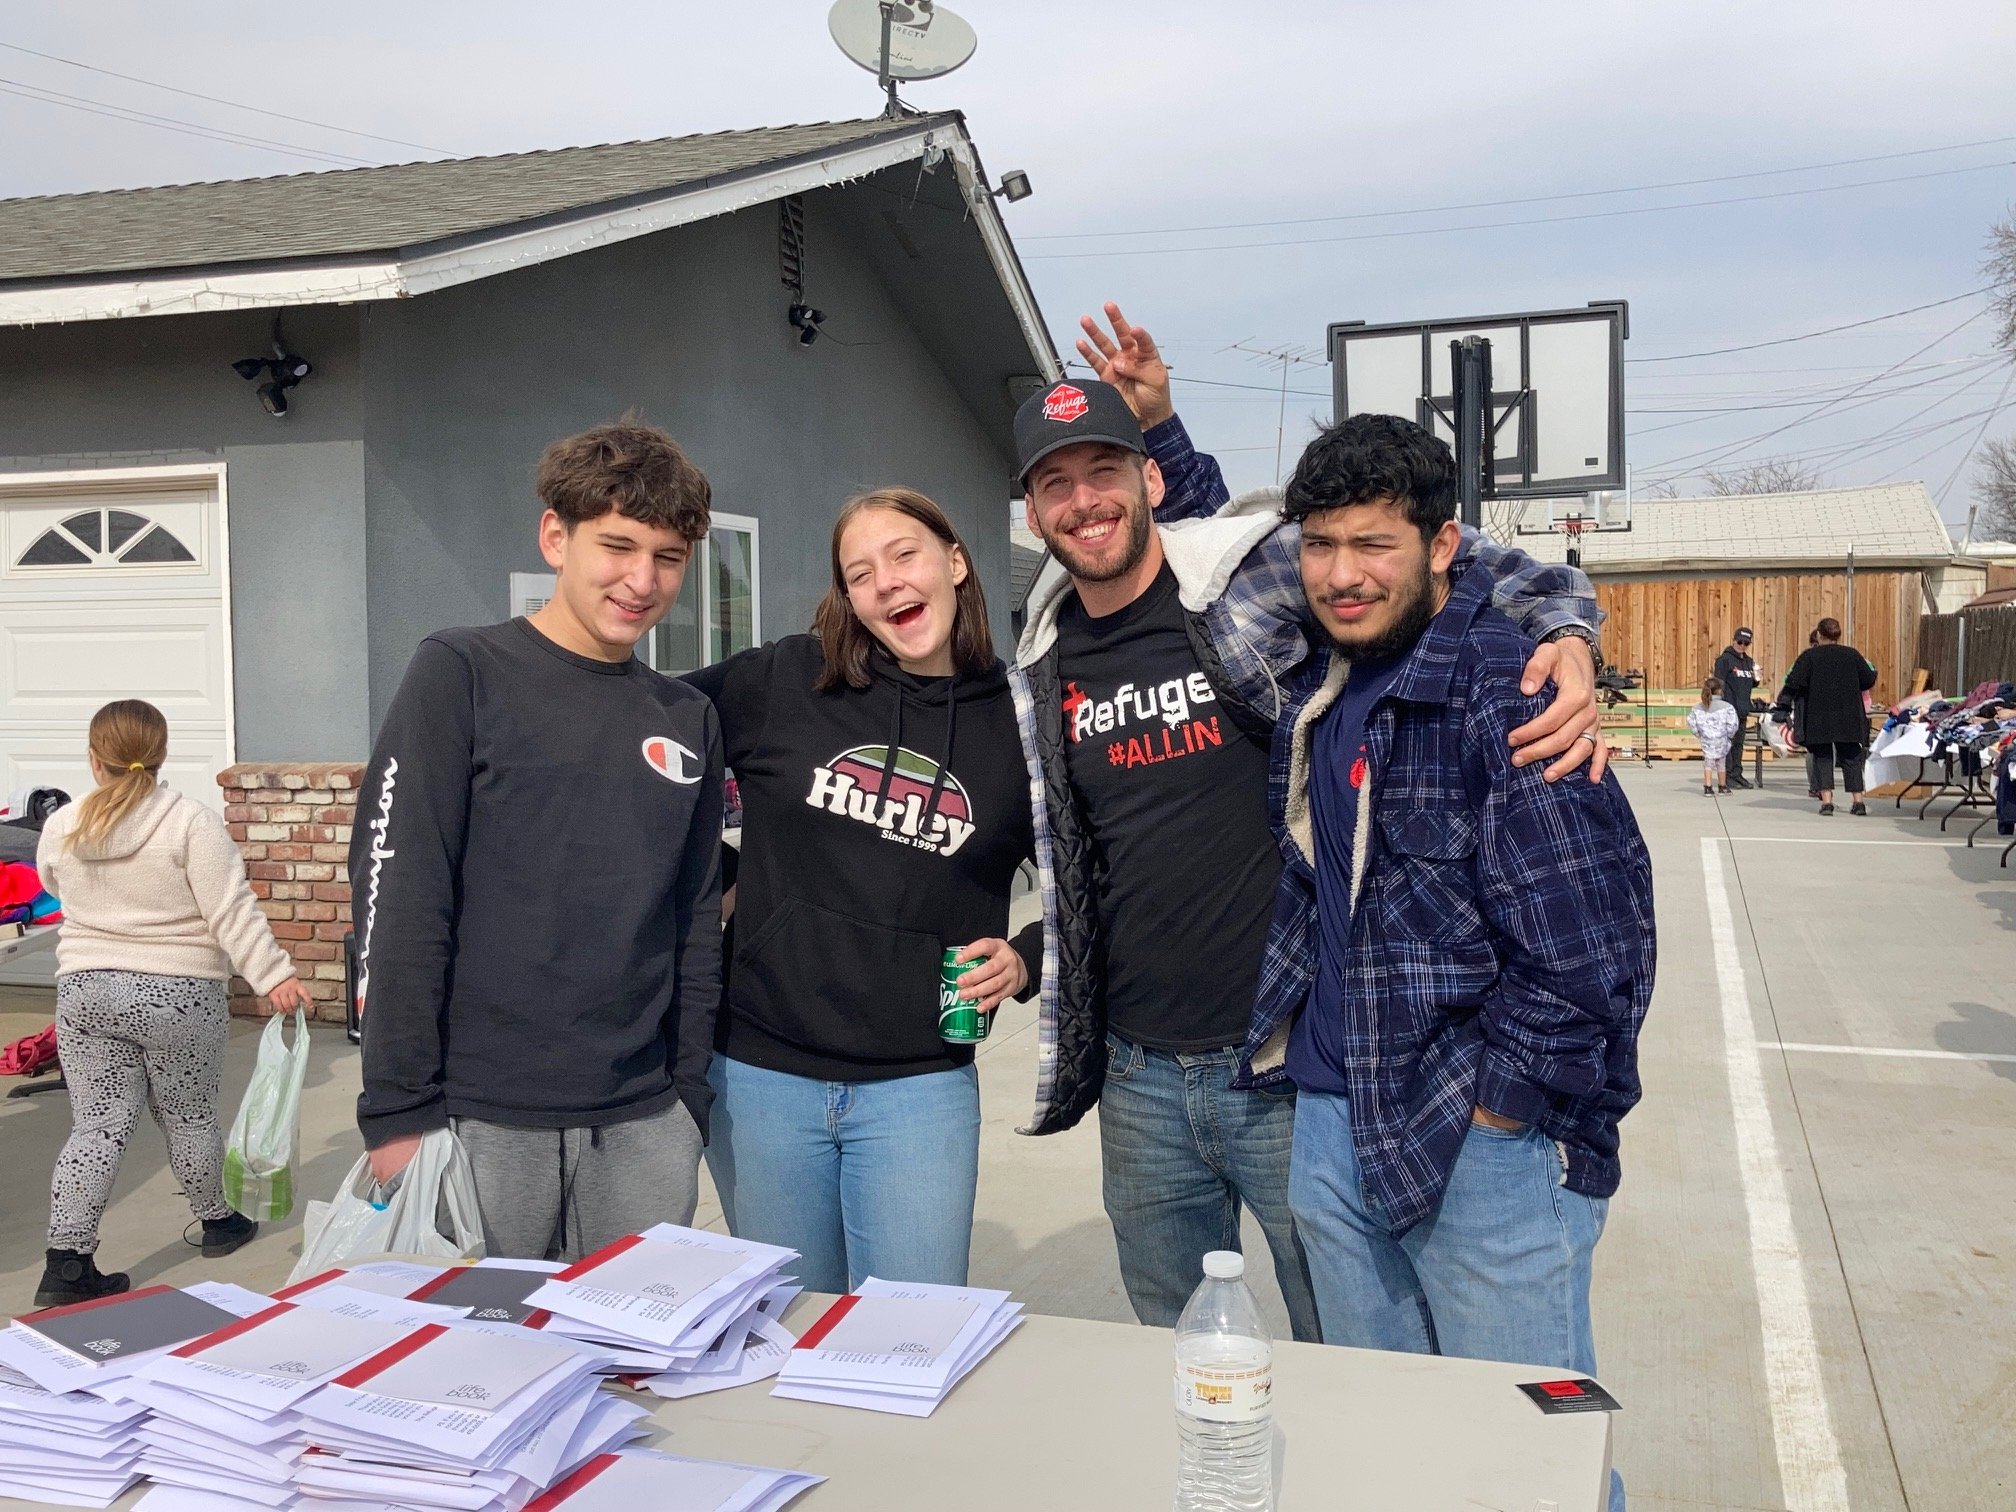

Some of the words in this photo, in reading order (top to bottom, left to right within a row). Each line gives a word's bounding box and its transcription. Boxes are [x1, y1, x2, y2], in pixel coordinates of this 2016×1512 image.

[891, 25, 926, 39] IRECTV
[1042, 391, 1088, 419] Refuge
[1074, 672, 1216, 742] Refuge
[1107, 716, 1223, 769] #ALLIN
[806, 767, 976, 857] Hurley
[881, 829, 911, 846] Since
[912, 837, 937, 853] 1999
[642, 1286, 679, 1299] book
[445, 1389, 490, 1401] book
[458, 1384, 486, 1394] life
